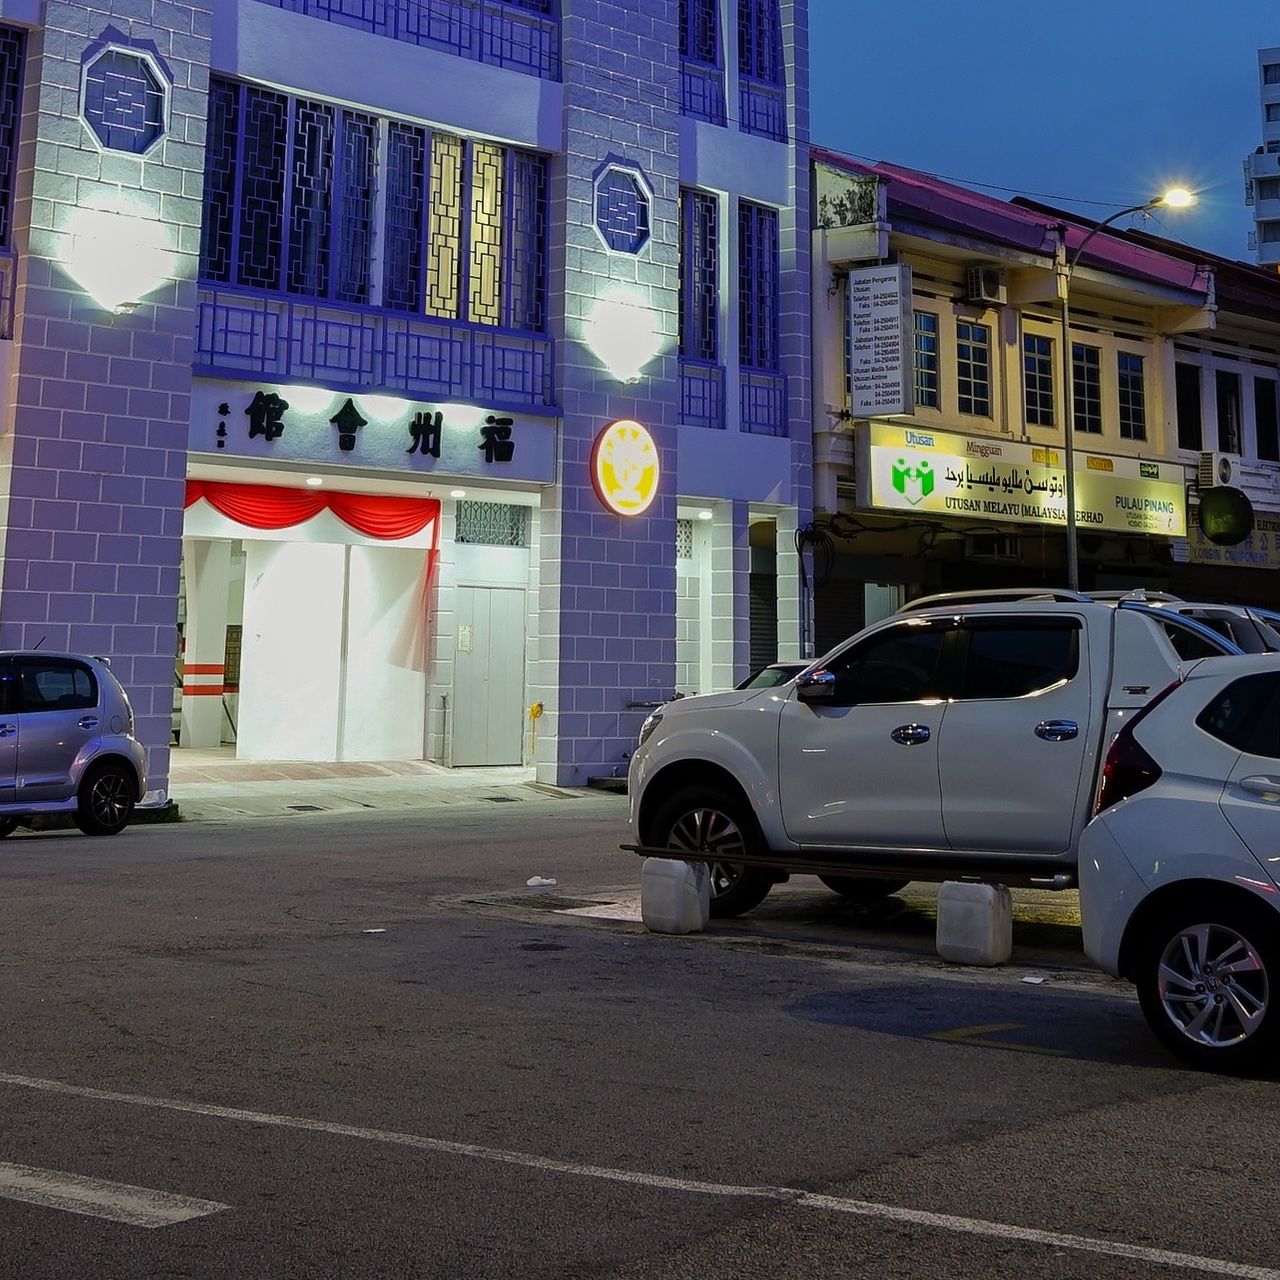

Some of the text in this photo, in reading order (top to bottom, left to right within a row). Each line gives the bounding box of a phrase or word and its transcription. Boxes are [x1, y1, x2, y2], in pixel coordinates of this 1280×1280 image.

[905, 431, 935, 447] Utusan
[966, 441, 1003, 458] Mingguan
[945, 497, 981, 512] UTUSAN
[983, 500, 1020, 516] MELAYU
[1073, 510, 1104, 524] ERHAD
[1115, 495, 1174, 514] PULAU PINANG
